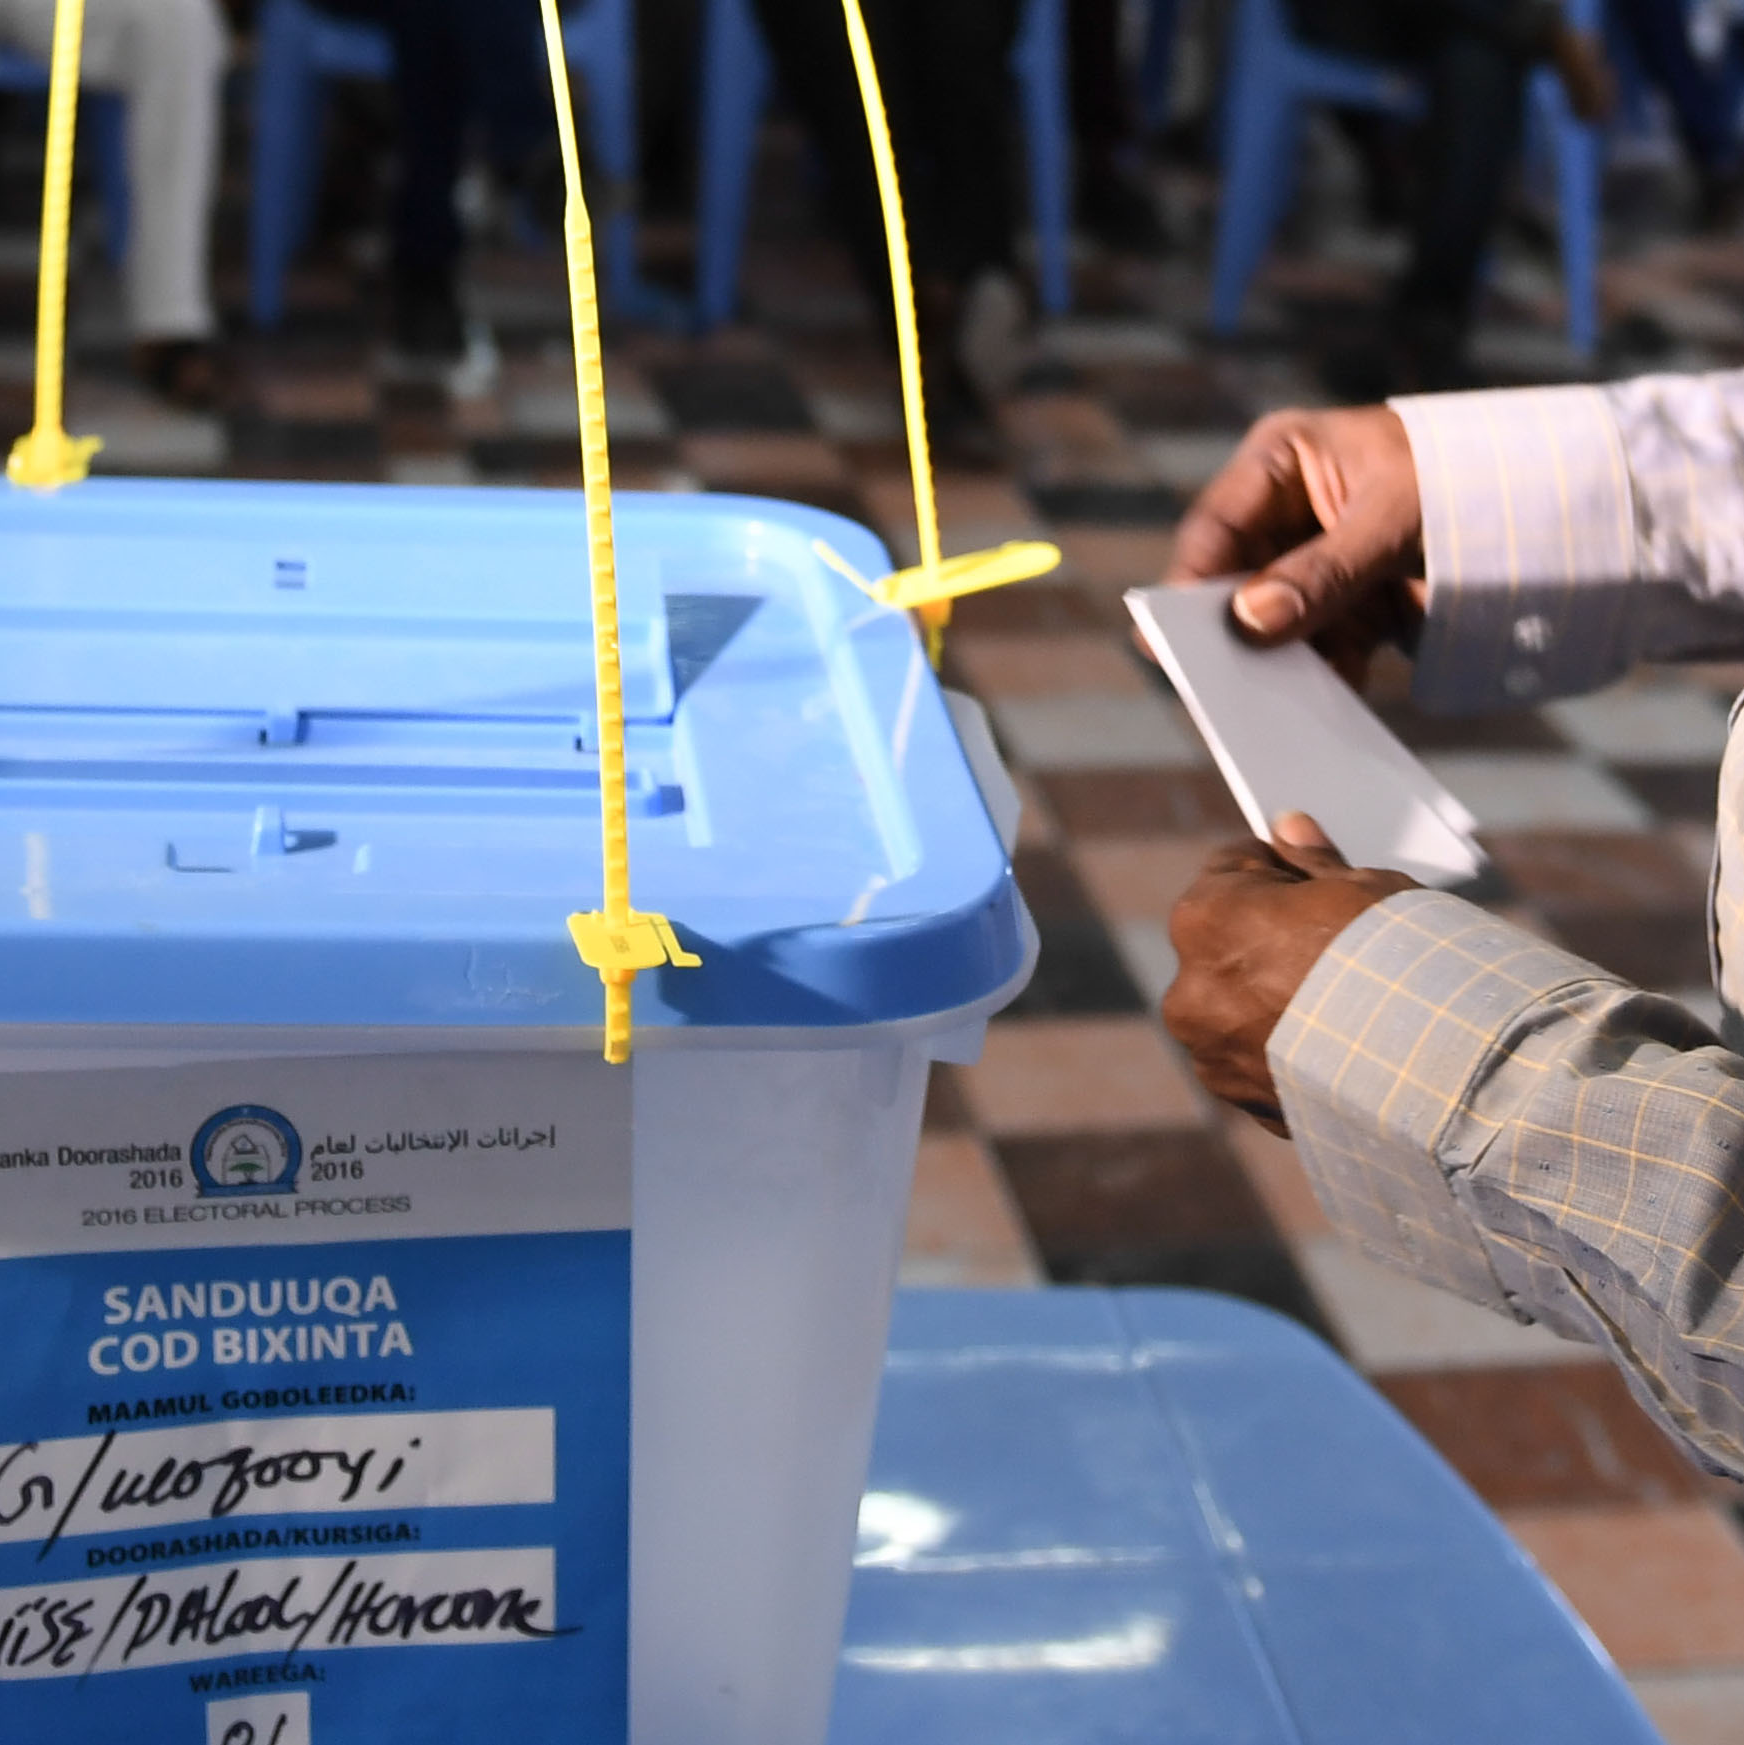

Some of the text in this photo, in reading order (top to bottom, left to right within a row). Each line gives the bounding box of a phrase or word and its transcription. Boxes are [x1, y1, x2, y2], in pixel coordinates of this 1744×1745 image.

[57, 1143, 182, 1167] Doorashada
[309, 1134, 355, 1161] لعام
[129, 1169, 184, 1190] 2016
[311, 1159, 364, 1182] 2016
[82, 1194, 412, 1227] 2016 ELECTORAL PROCESS
[103, 1275, 399, 1325] SANDUUQA
[87, 1321, 414, 1376] COD BIXINTA
[87, 1382, 417, 1425] MAAMUL GOBOLEEDKA:
[85, 1522, 421, 1568] DOORASHADA/KURSIGA:
[189, 1663, 326, 1694] WAREEGA:
